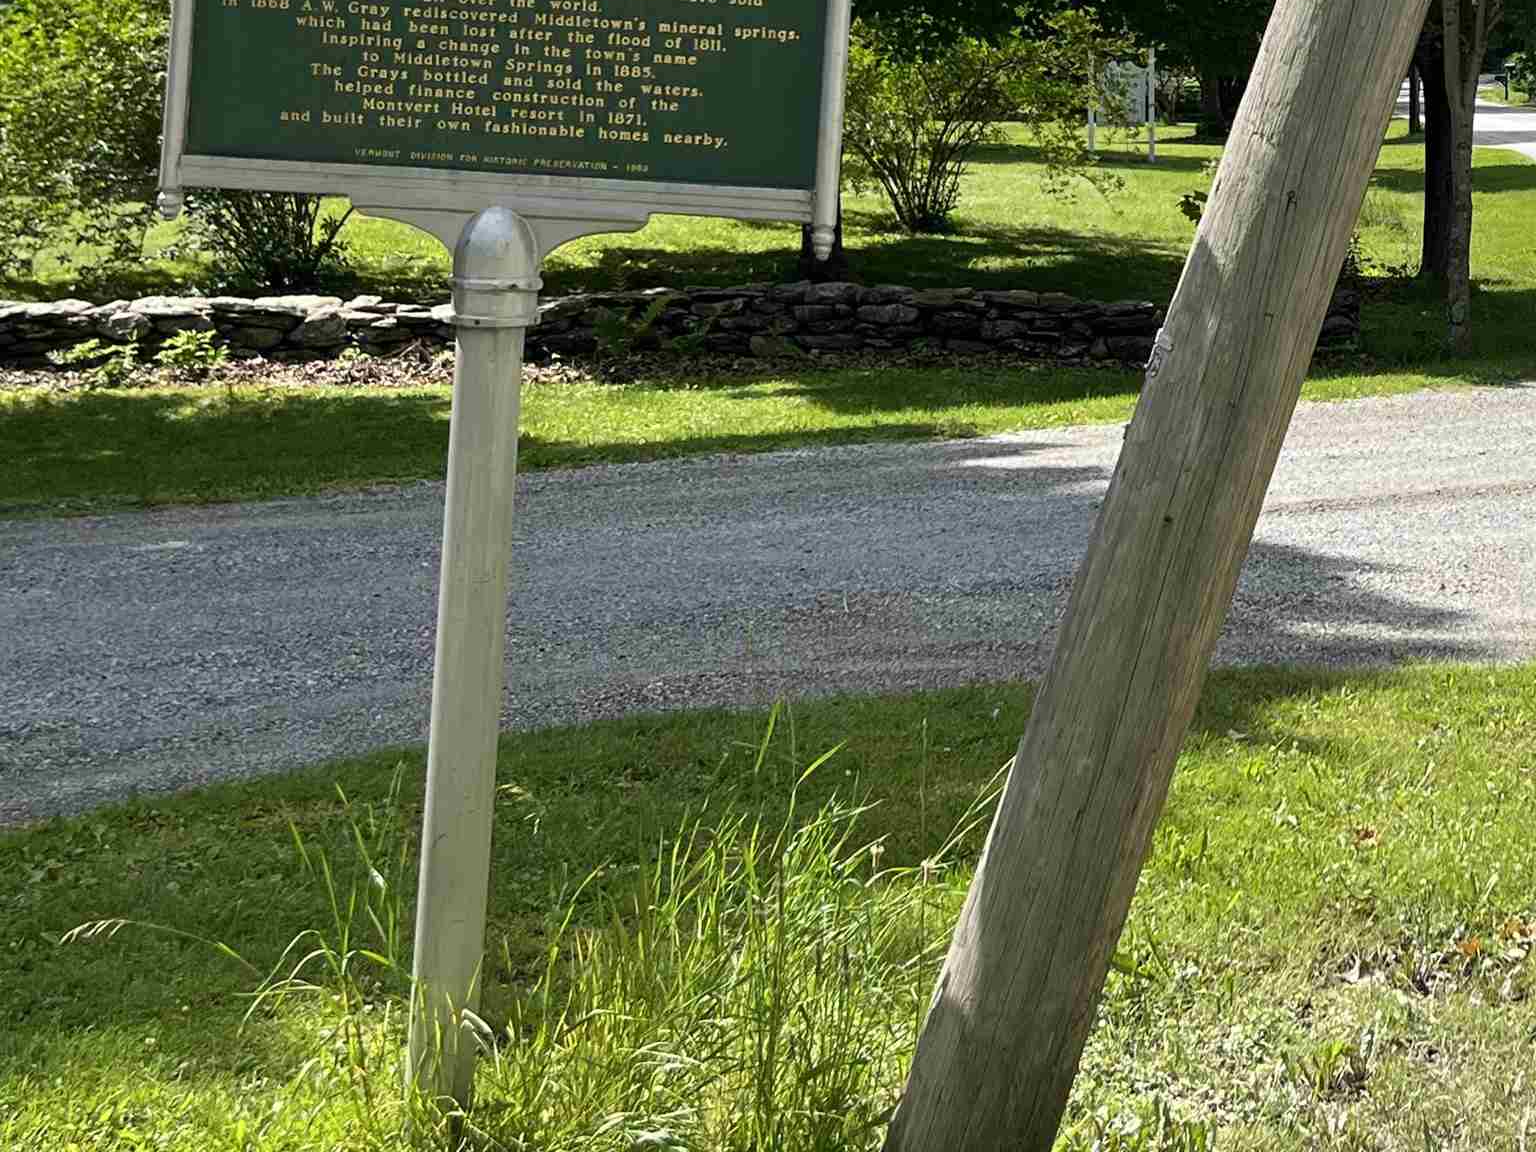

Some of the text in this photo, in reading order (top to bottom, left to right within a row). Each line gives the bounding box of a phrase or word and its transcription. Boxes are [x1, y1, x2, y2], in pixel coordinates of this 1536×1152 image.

[295, 15, 345, 29] which
[360, 17, 391, 32] had
[408, 20, 448, 35] been
[463, 23, 495, 37] lost
[509, 27, 552, 41] after
[567, 30, 594, 43] the
[607, 32, 650, 47] flood
[664, 36, 682, 49] of
[347, 1, 390, 17] Gray
[403, 6, 517, 23] rediscovered
[658, 21, 722, 36] mineral
[322, 31, 402, 50] inspiring
[416, 39, 425, 49] a
[438, 39, 499, 55] change
[514, 42, 530, 55] in
[543, 44, 571, 58] the
[652, 53, 697, 65] name
[362, 51, 379, 62] to
[393, 51, 492, 69] Middletown
[505, 58, 572, 75] Springs
[586, 62, 601, 76] in
[309, 62, 341, 76] The
[357, 65, 408, 81] Grays
[423, 69, 488, 85] bottled
[503, 75, 533, 87] and
[546, 77, 581, 90] sold
[595, 79, 623, 92] the
[334, 79, 679, 111] helped finance construction of the
[362, 97, 439, 113] Montvert
[451, 102, 496, 117] Hotel
[511, 108, 563, 120] resort
[579, 110, 594, 123] in
[279, 110, 310, 122] and
[321, 110, 364, 125] built
[379, 114, 422, 128] their
[436, 119, 470, 131] own
[484, 120, 584, 138] fashionable
[598, 127, 649, 142] homes
